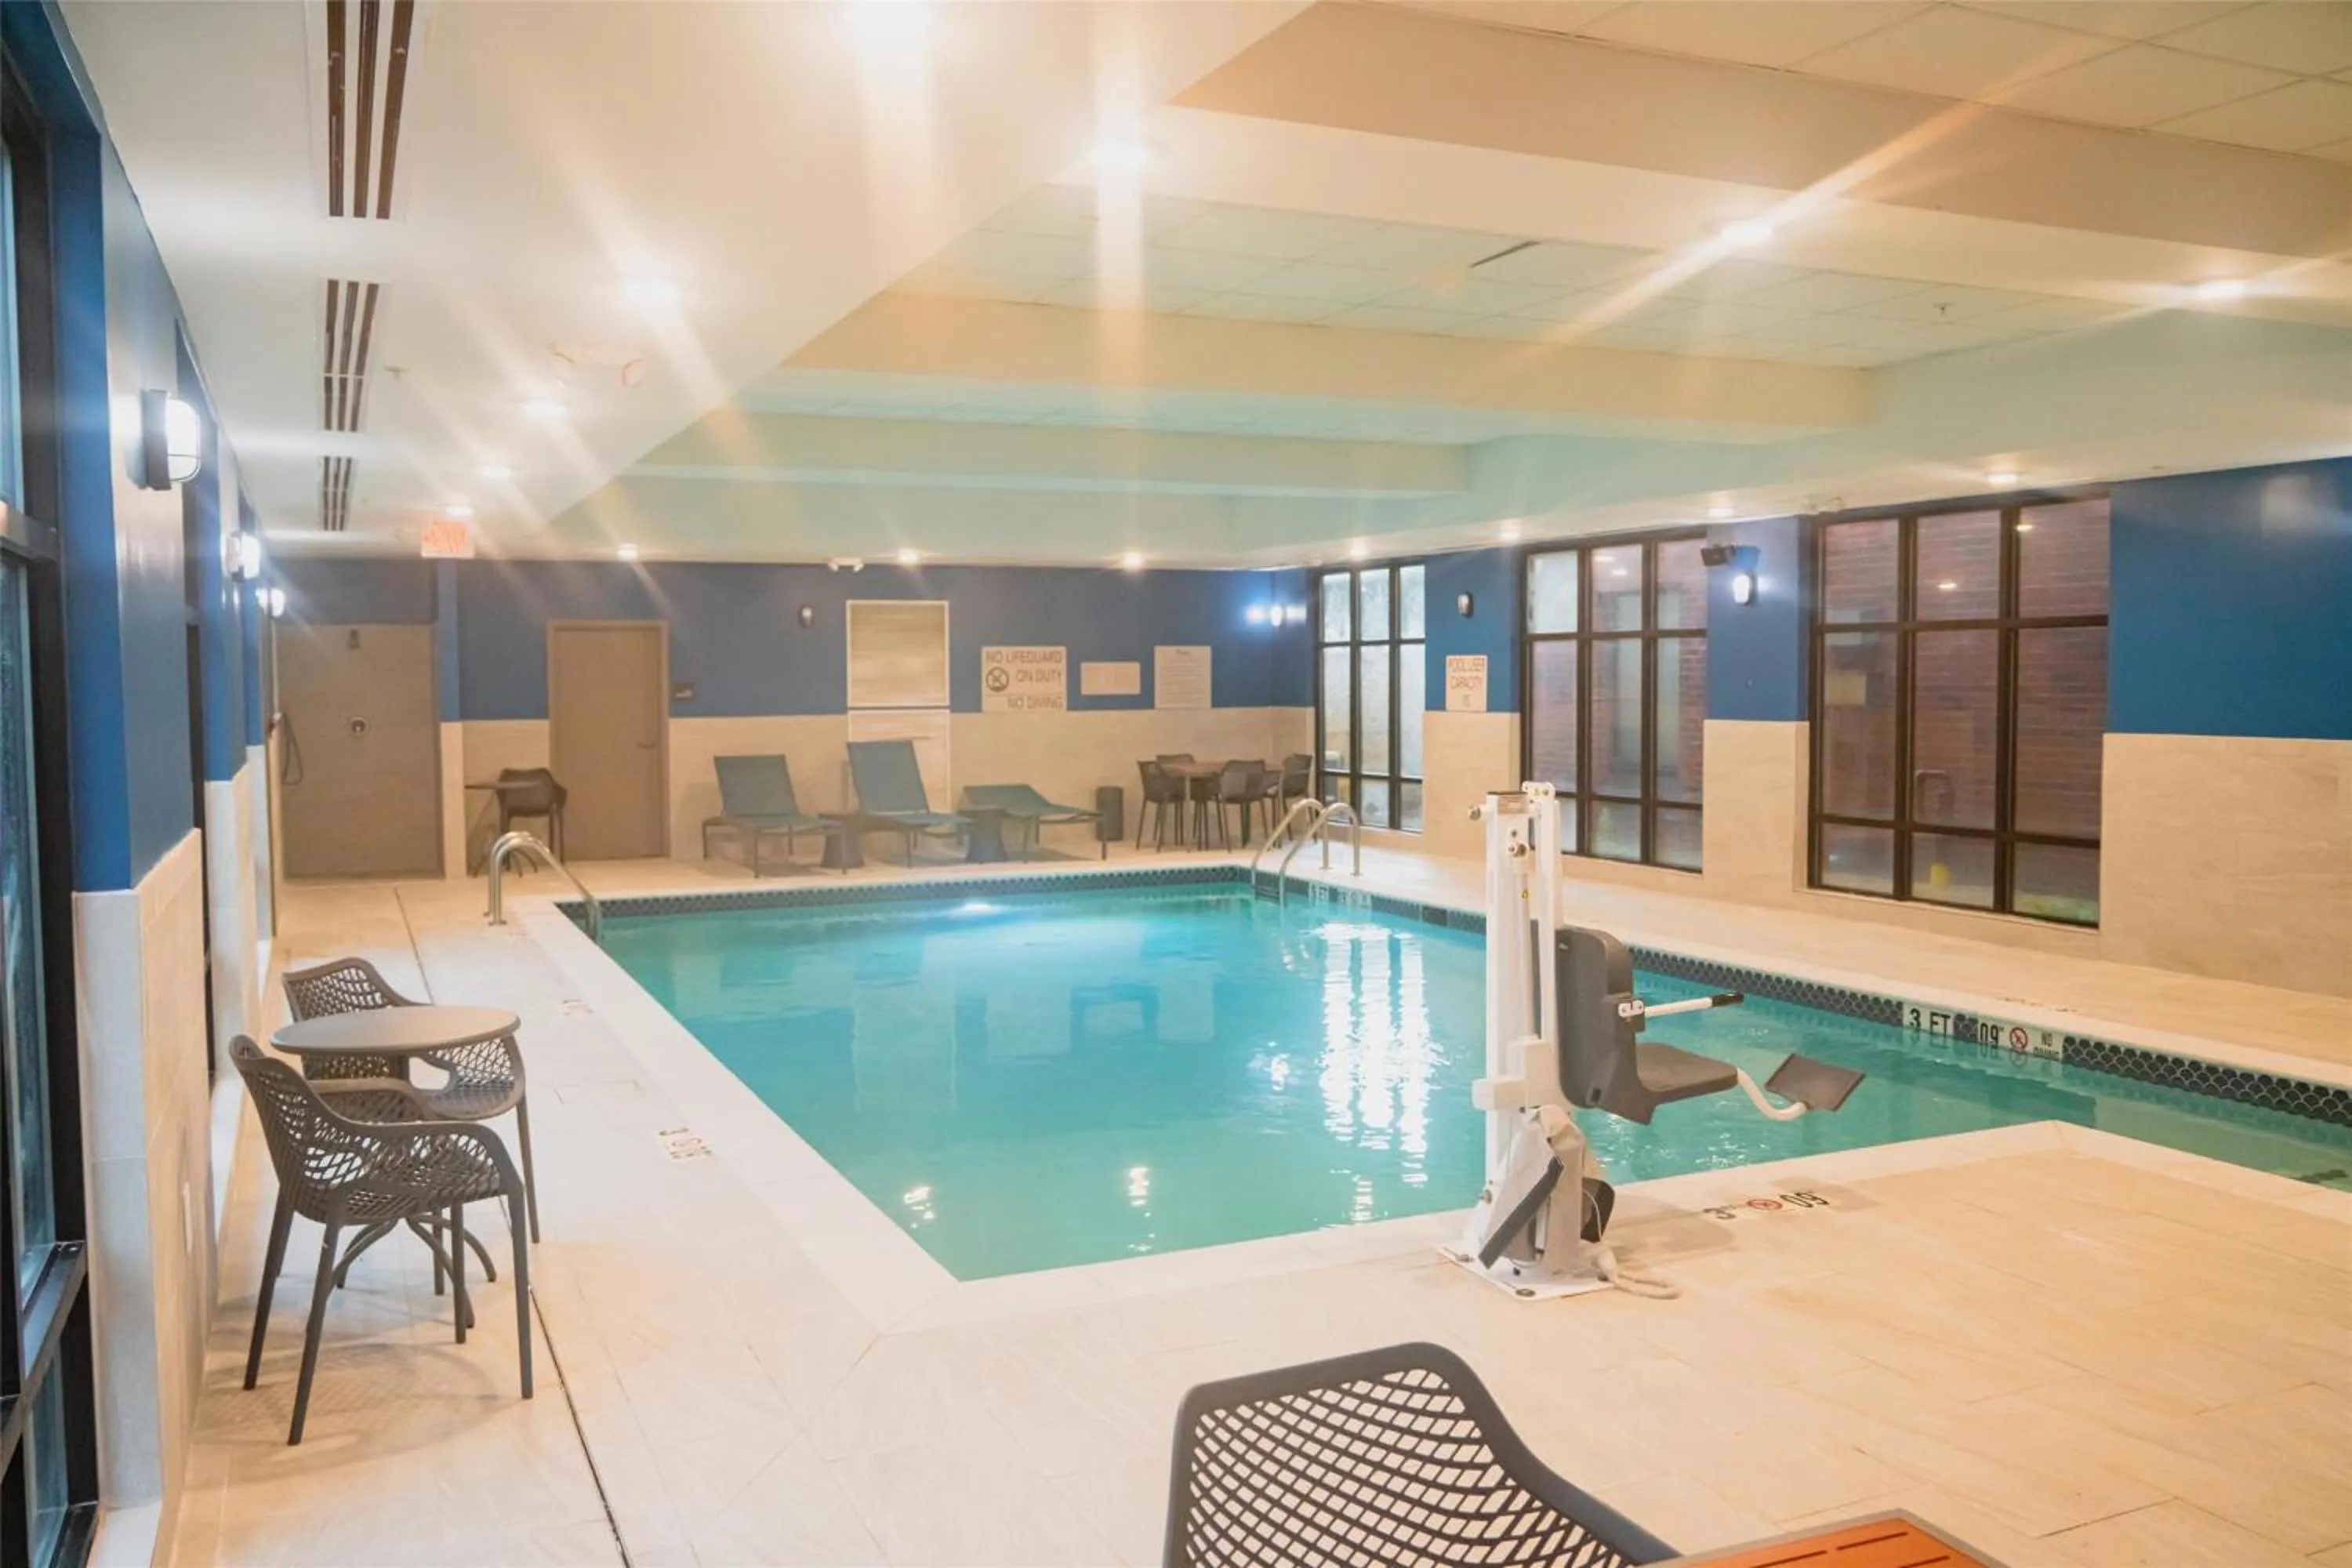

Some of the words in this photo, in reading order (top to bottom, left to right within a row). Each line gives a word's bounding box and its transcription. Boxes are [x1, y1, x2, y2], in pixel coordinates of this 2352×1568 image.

[985, 650, 1003, 664] NO
[1006, 650, 1062, 663] LIFEGUARD
[1016, 669, 1033, 683] ON
[1035, 669, 1062, 682] DUTY
[1007, 695, 1024, 710] NO
[1026, 695, 1064, 709] DIVING
[1909, 1007, 1921, 1032] 3
[1929, 1011, 1951, 1036] FT
